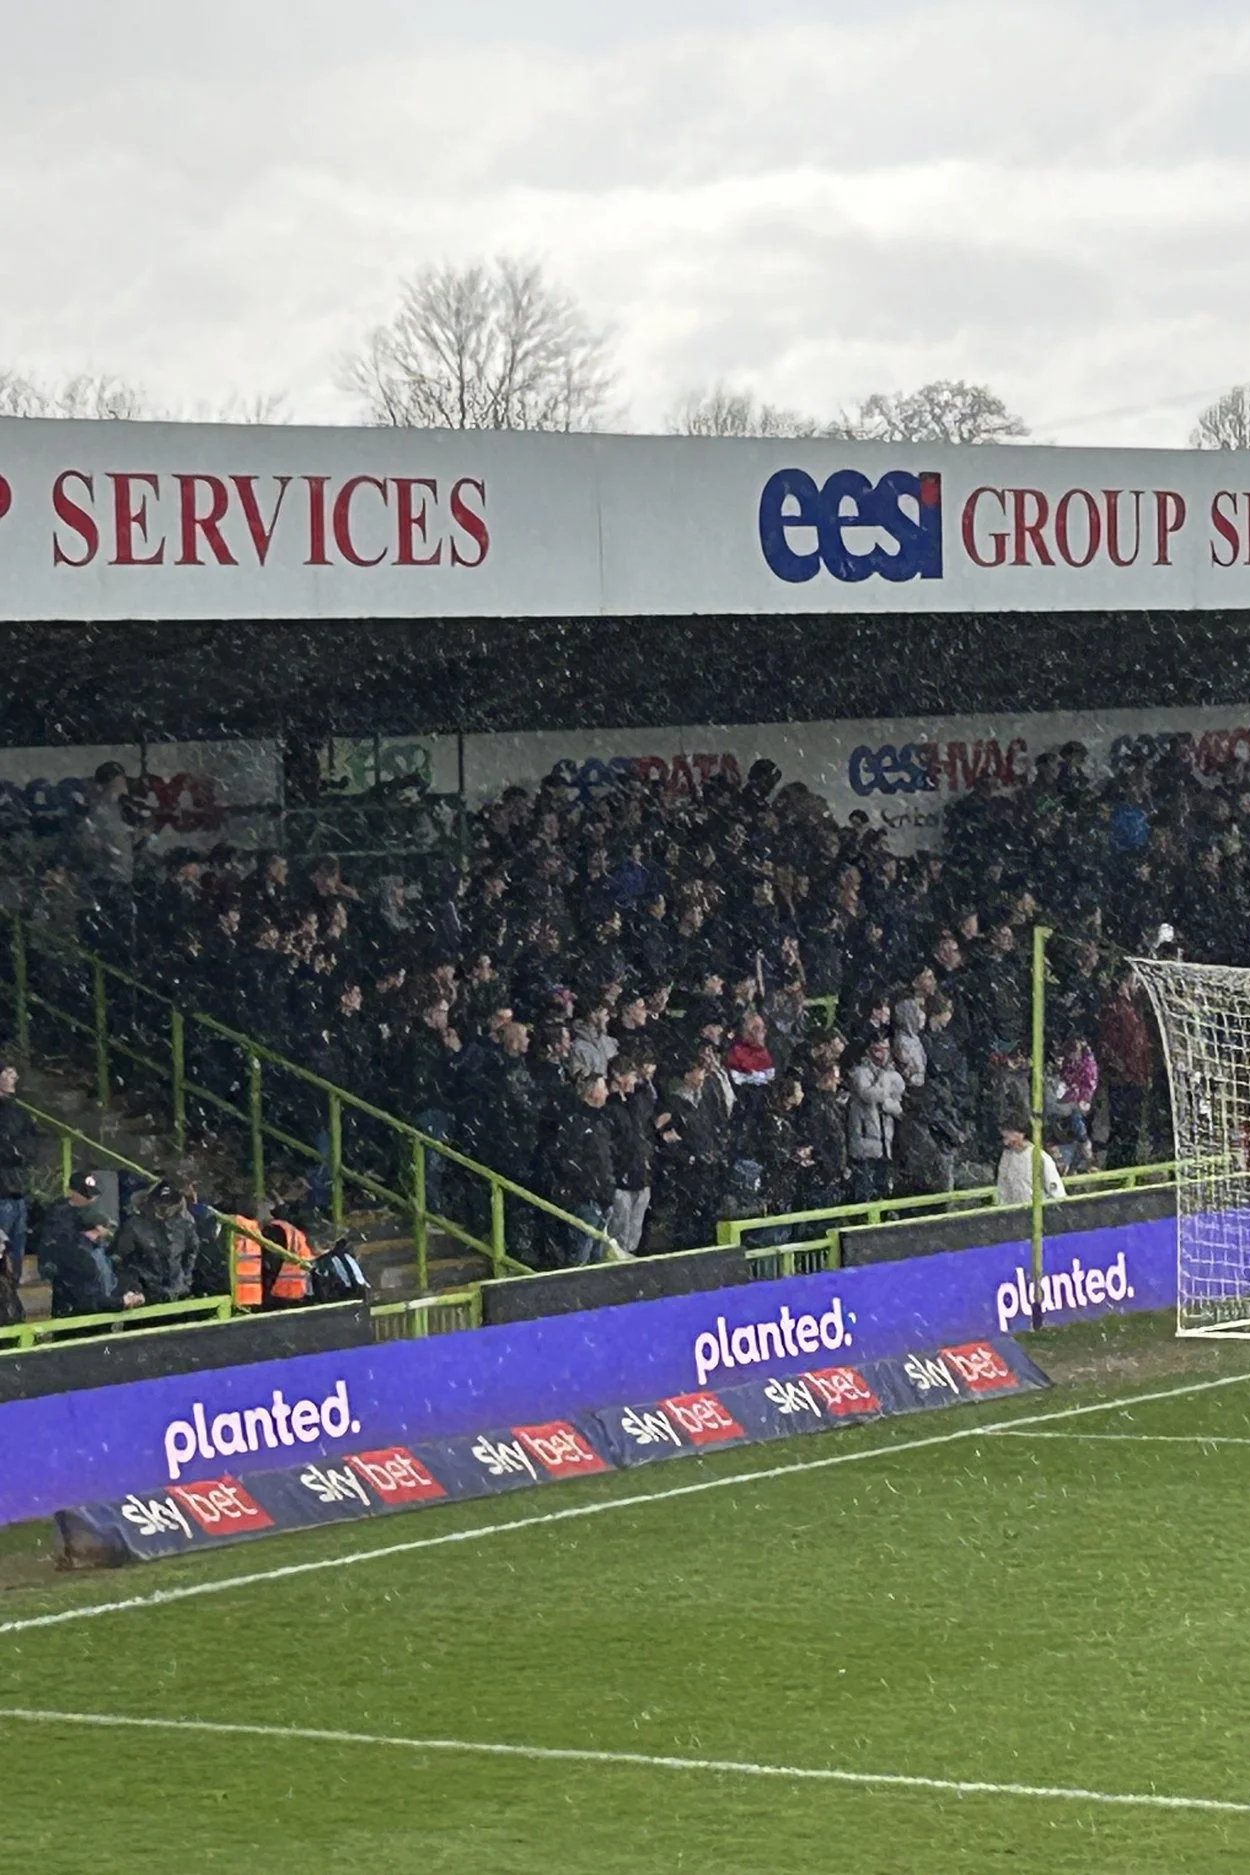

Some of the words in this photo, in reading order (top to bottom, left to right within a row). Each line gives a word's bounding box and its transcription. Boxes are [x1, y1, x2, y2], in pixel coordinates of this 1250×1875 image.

[52, 470, 490, 568] SERVICES
[961, 486, 1186, 568] GROUP
[765, 1377, 822, 1418] sky
[808, 1369, 872, 1406] bet
[903, 1353, 960, 1395] sky
[946, 1345, 1009, 1380] bet
[164, 1380, 361, 1479] planted.
[622, 1406, 682, 1447] sky
[666, 1396, 734, 1432] bet
[301, 1462, 371, 1506] sky
[351, 1453, 434, 1491] bet
[473, 1436, 538, 1481] sky
[519, 1430, 594, 1466] bet
[121, 1494, 193, 1539] sky
[182, 1481, 259, 1523] bet
